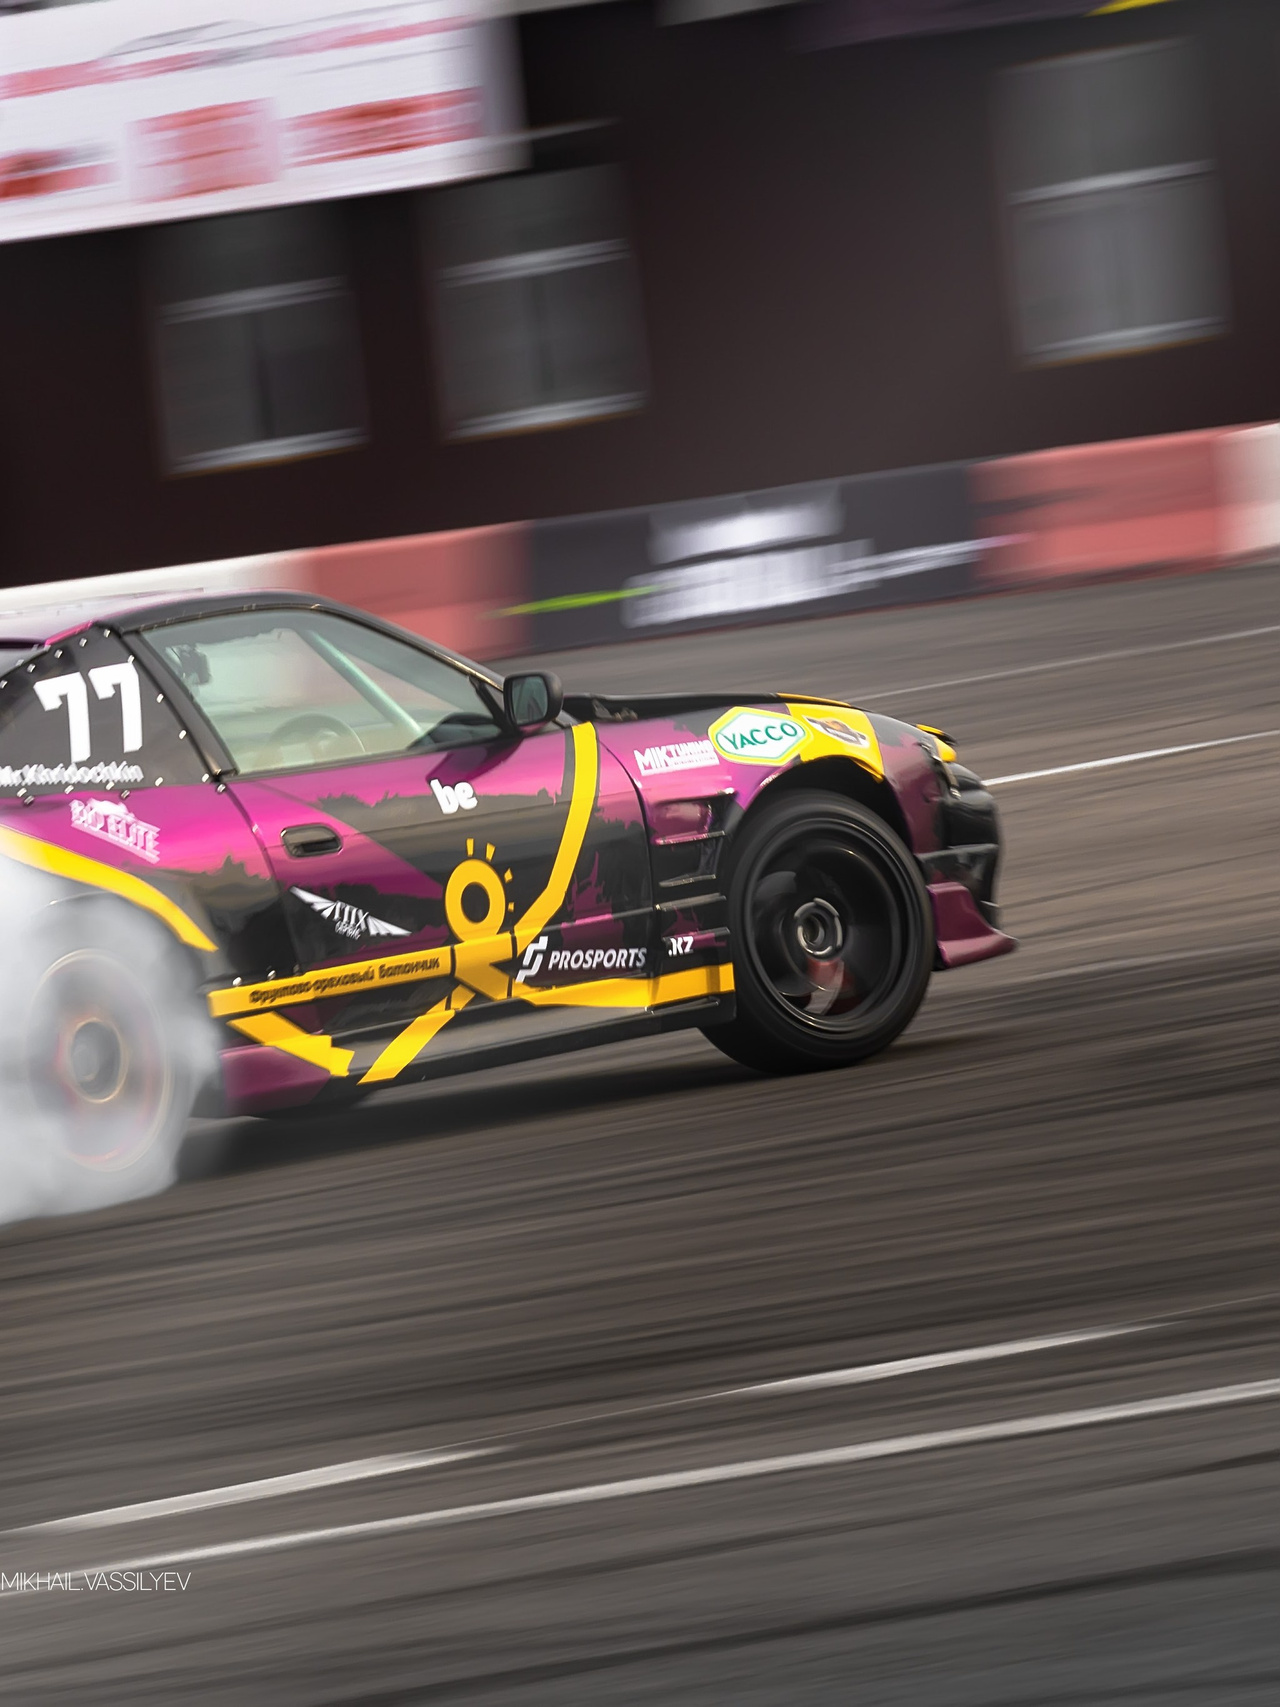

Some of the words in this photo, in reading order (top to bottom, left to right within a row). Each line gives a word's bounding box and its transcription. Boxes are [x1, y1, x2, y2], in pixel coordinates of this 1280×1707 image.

[33, 662, 142, 763] 77
[721, 722, 798, 750] YACCO
[430, 779, 478, 814] be
[548, 948, 647, 970] PROSPORTS
[668, 936, 694, 956] .KZ
